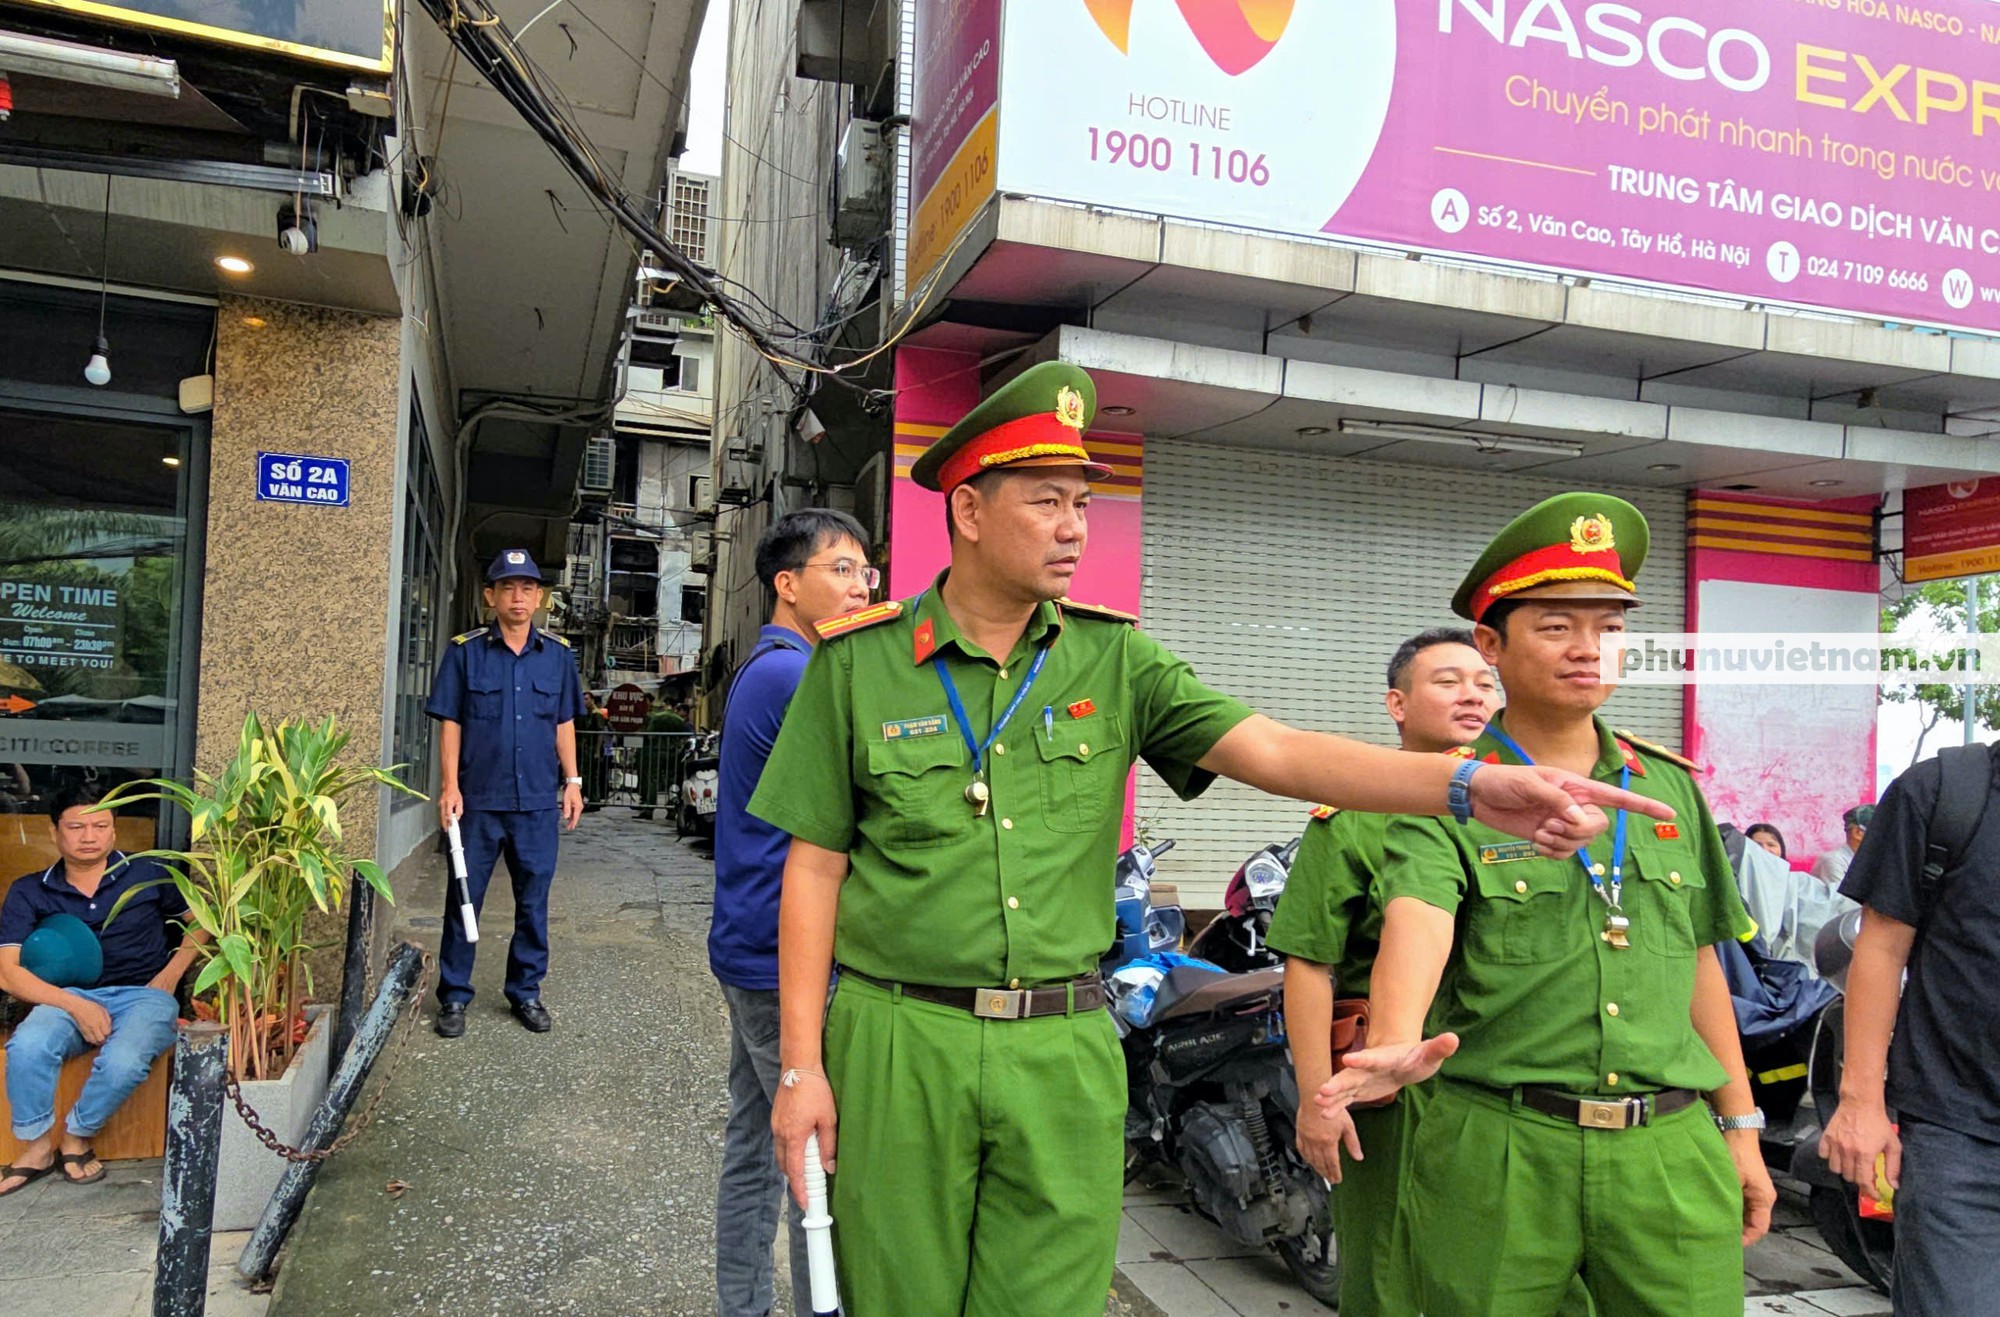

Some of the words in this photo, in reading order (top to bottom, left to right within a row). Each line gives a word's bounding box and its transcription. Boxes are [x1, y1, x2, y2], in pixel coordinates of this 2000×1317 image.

[1896, 4, 1963, 36] NASCO
[973, 38, 990, 70] CAO
[1438, 0, 1771, 92] NASCO
[1129, 92, 1231, 131] HOTLINE
[1505, 74, 1629, 126] Chuyển
[1638, 102, 1711, 140] phát
[1719, 117, 1812, 158] nhanh
[1821, 133, 1895, 179] trong
[1088, 127, 1171, 171] 1900
[1190, 142, 1270, 186] 1106
[940, 182, 961, 228] 1900
[964, 145, 989, 197] 1106
[1608, 165, 1699, 203] TRUNG
[1707, 179, 1763, 215] TÂM
[1771, 193, 1842, 227] GIAO
[1851, 203, 1912, 239] DỊCH
[1920, 215, 1973, 250] VĂN
[1441, 198, 1459, 222] A
[1477, 205, 1504, 227] Số
[1506, 210, 1522, 233] 2,
[1528, 213, 1566, 237] Văn
[1571, 220, 1616, 247] Cao,
[1621, 227, 1652, 253] Tây
[1657, 232, 1686, 258] Hồ,
[1691, 239, 1715, 260] Hà
[1720, 244, 1750, 269] Nội
[1779, 251, 1789, 273] T
[1807, 256, 1838, 279] 024
[1844, 261, 1884, 285] 7109
[1888, 269, 1928, 292] 6666
[1949, 277, 1967, 300] W
[270, 460, 303, 481] SỐ
[308, 466, 338, 484] 2A
[269, 483, 302, 498] VĂN
[306, 487, 338, 501] CAO
[1961, 557, 1984, 568] 1900
[0, 582, 51, 602] PEN
[59, 586, 117, 607] TIME
[11, 602, 87, 621] Welcome
[16, 655, 34, 664] TO
[39, 656, 77, 667] MEET
[81, 658, 113, 669] YOU!
